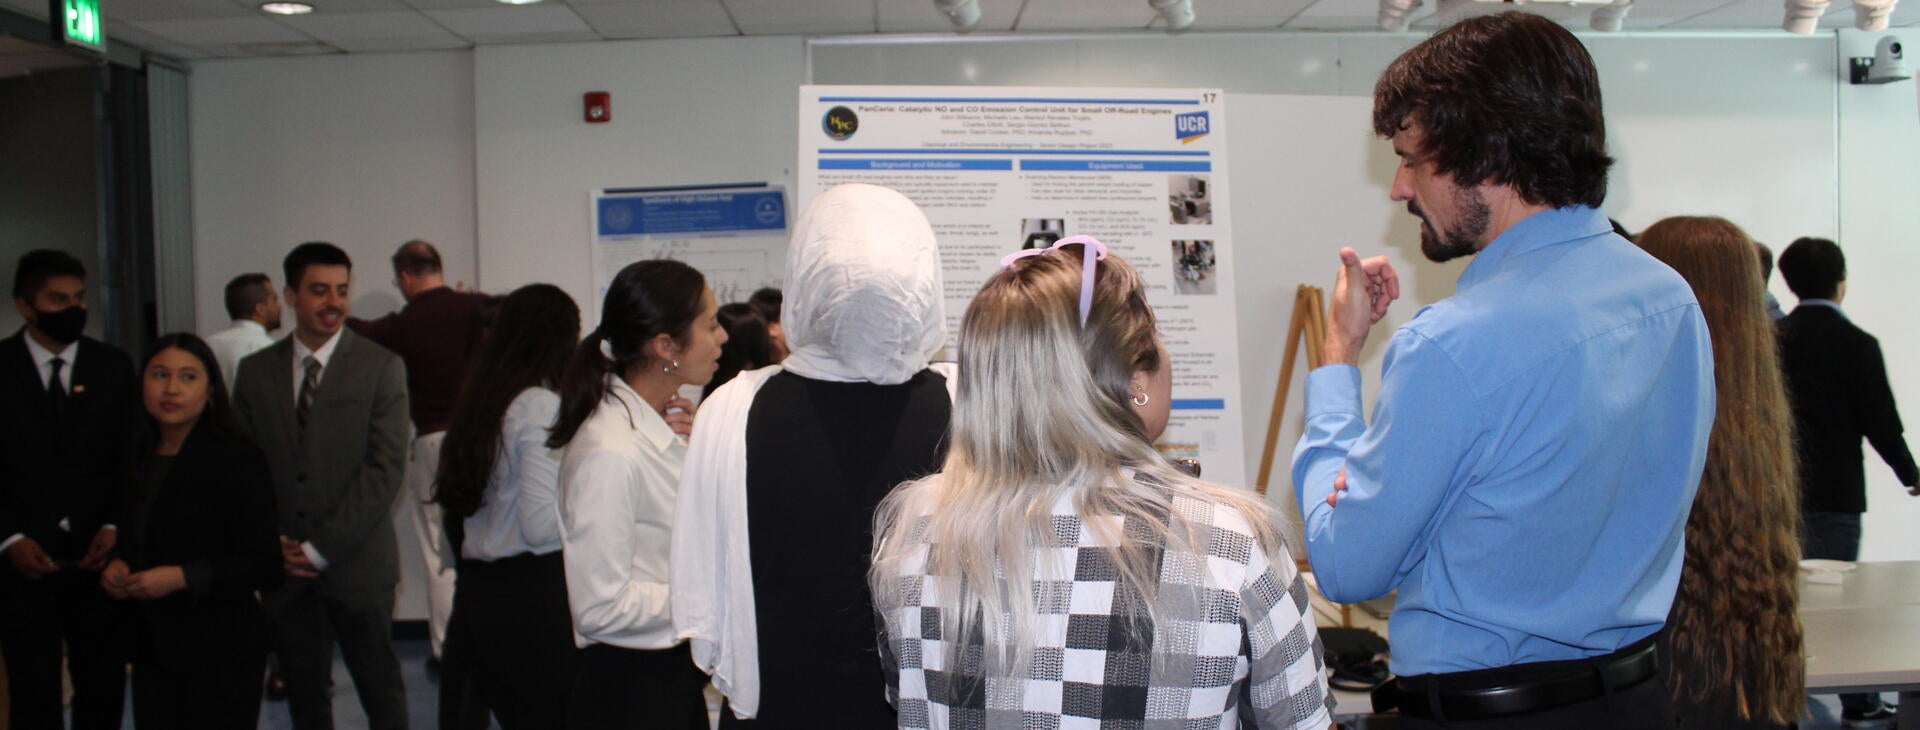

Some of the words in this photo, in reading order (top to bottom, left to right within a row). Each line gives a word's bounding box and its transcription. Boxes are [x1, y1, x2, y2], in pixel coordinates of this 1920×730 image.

[1203, 93, 1216, 103] 17
[899, 105, 932, 114] Catalytic
[935, 105, 947, 113] NO
[950, 105, 963, 113] and
[1068, 106, 1079, 114] for
[1081, 106, 1102, 114] Small
[1141, 107, 1172, 116] Engines
[1178, 115, 1207, 132] UCR
[871, 160, 913, 170] Background
[1089, 161, 1124, 171] Equipment
[1125, 161, 1144, 169] Used
